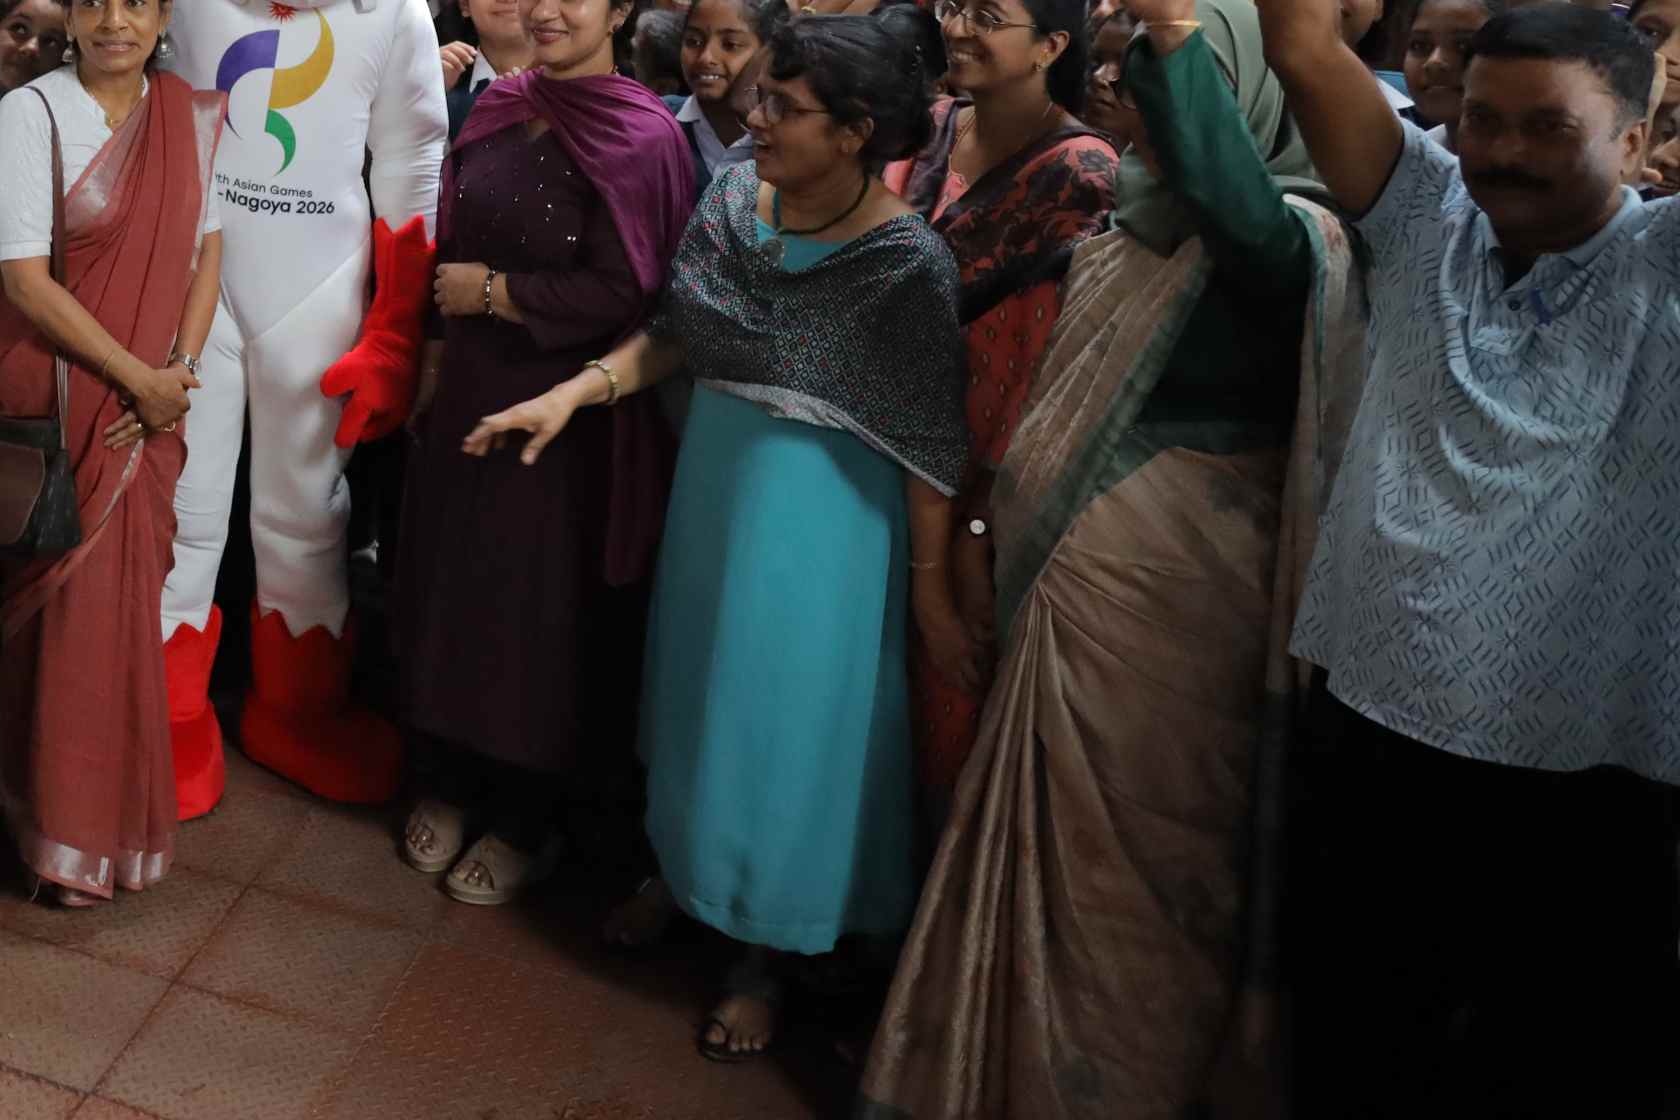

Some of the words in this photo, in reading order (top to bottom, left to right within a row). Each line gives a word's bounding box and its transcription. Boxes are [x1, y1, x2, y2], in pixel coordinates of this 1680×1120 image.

[215, 172, 229, 185] th
[233, 178, 267, 194] Asian
[270, 184, 313, 198] Games
[296, 201, 336, 215] 2026
